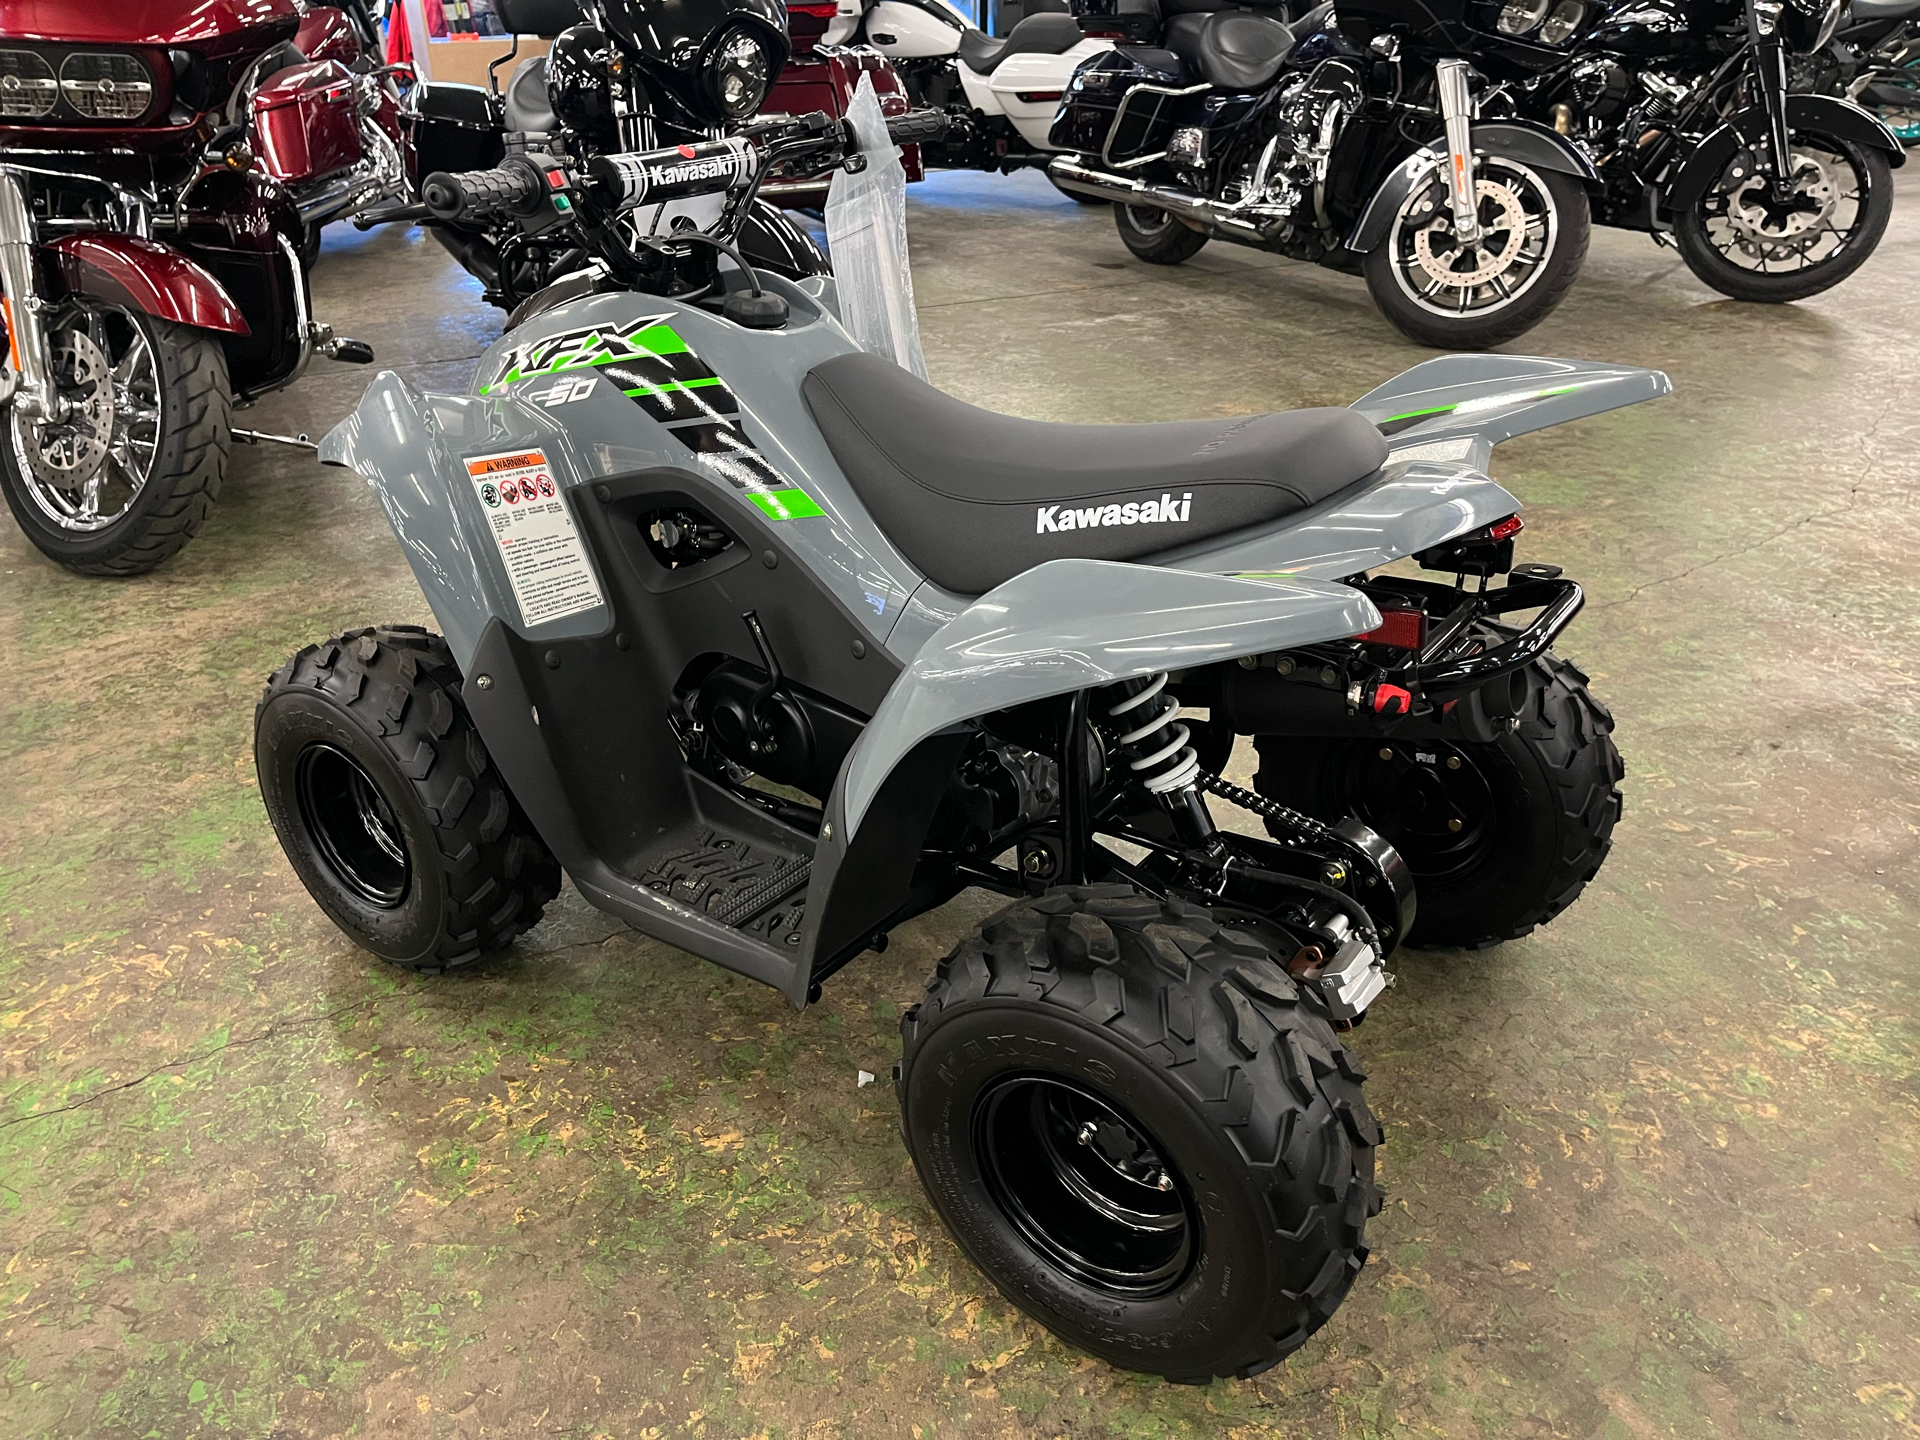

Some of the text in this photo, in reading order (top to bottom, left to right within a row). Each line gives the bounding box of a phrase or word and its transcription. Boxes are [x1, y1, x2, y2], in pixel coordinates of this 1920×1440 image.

[649, 159, 734, 187] Kawasaki
[488, 312, 679, 391] KFX
[544, 377, 599, 408] 50
[494, 457, 530, 470] WARNING
[1036, 492, 1193, 534] Kawasaki
[935, 1034, 1117, 1088] MAXXIS
